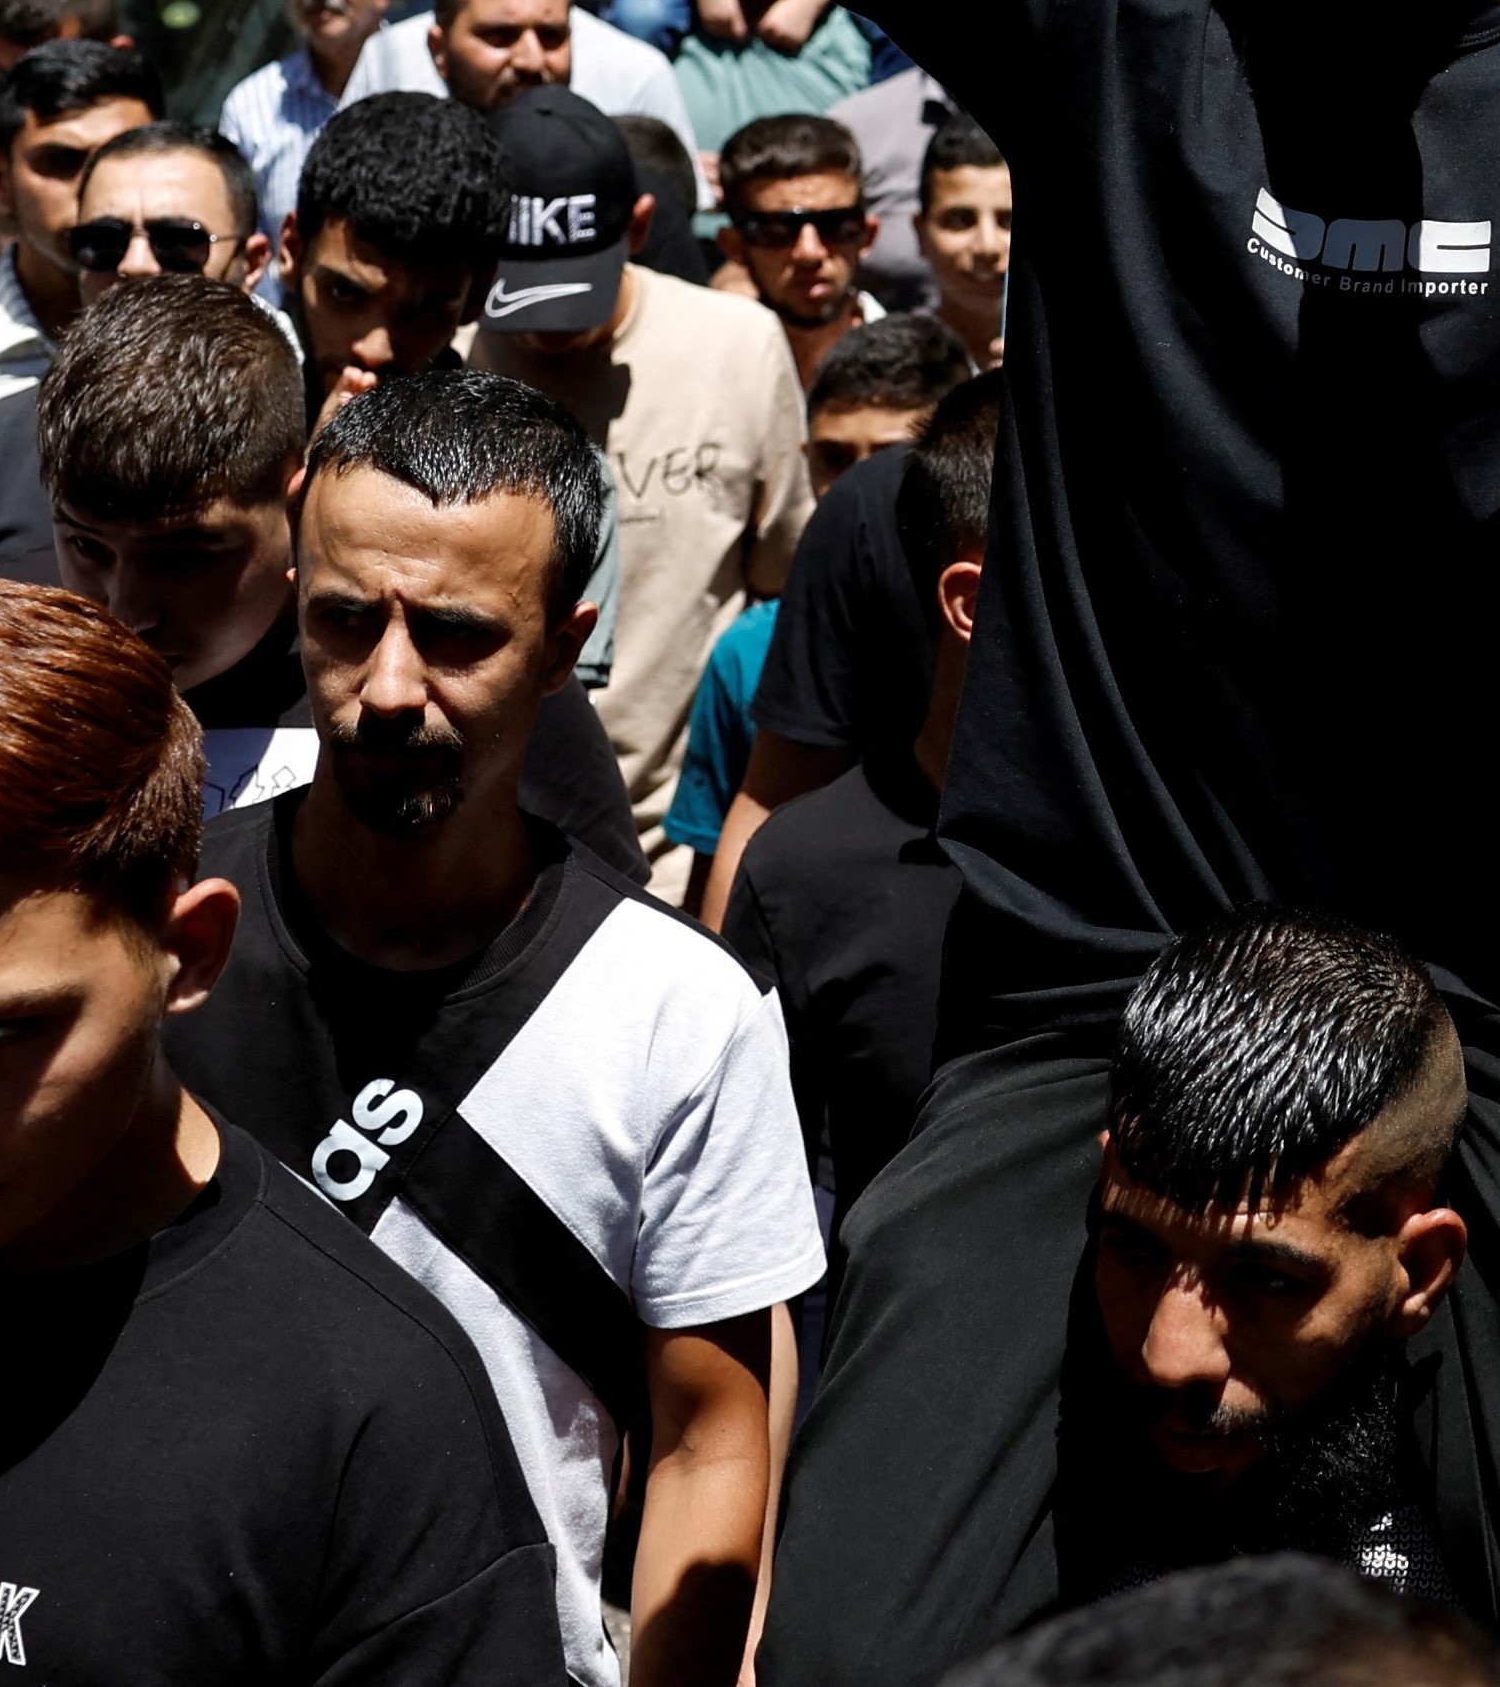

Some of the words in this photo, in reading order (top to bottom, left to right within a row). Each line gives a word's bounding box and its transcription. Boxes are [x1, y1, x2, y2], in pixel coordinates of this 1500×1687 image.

[1246, 237, 1332, 288] Customer
[1338, 276, 1394, 295] Brand
[1401, 277, 1489, 298] Importer
